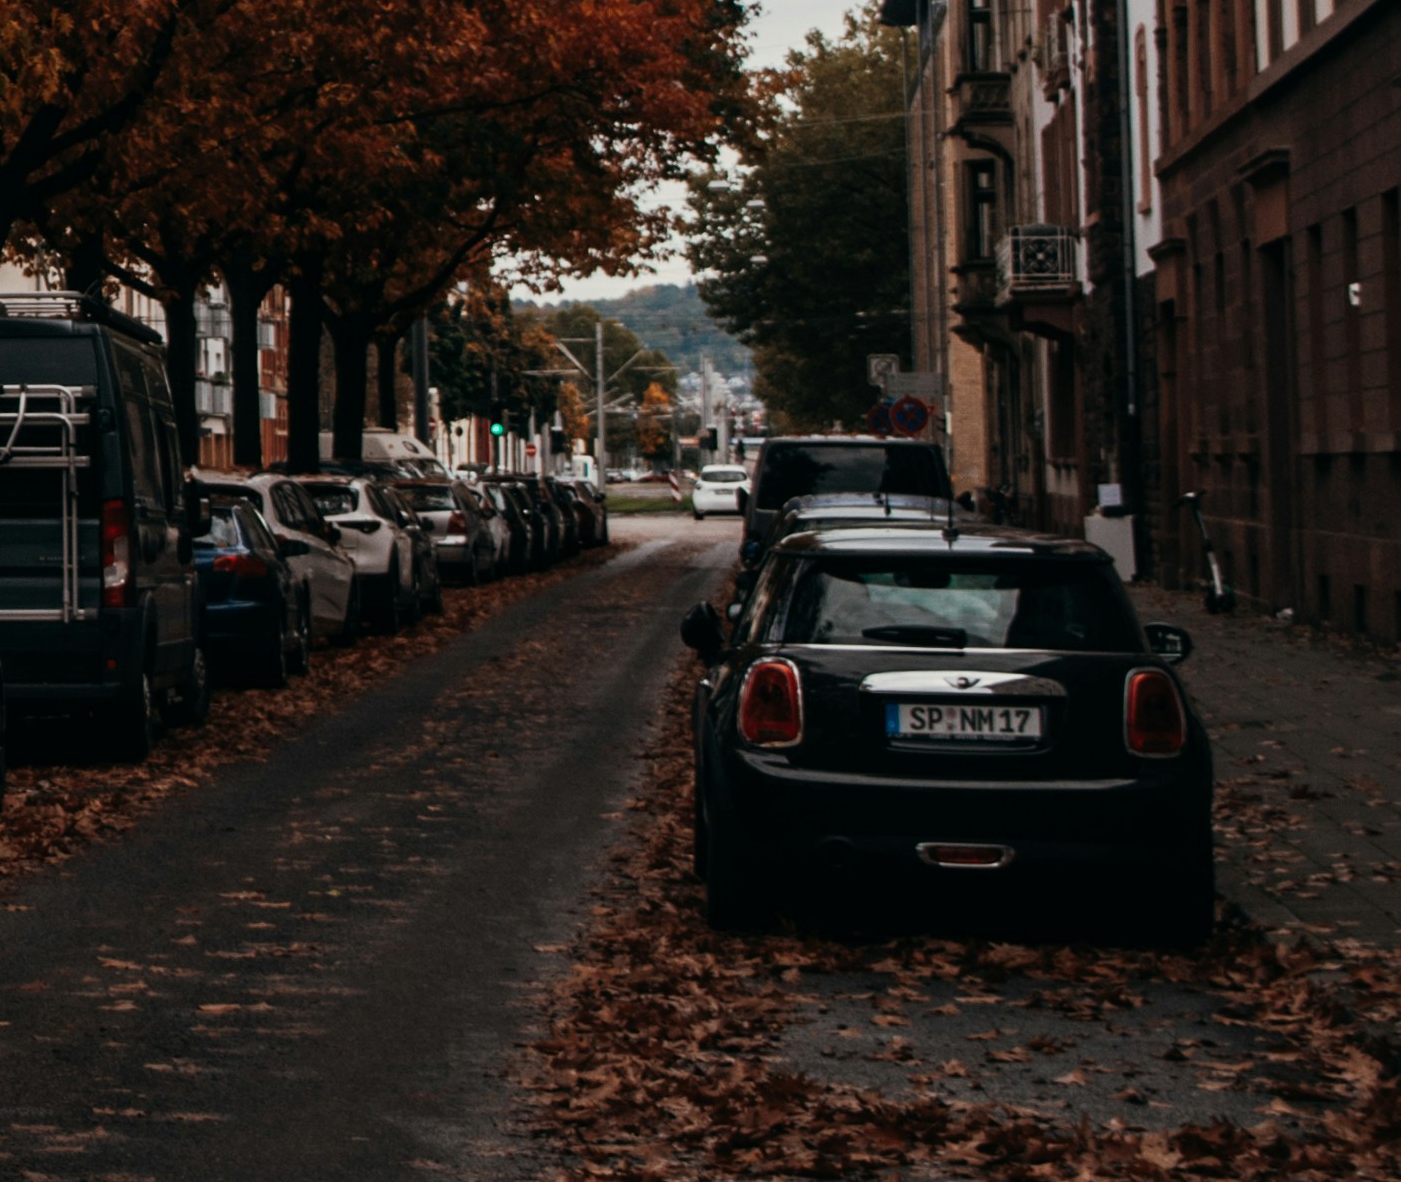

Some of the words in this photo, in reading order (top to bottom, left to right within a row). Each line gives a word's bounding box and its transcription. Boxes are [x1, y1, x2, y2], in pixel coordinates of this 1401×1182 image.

[910, 707, 942, 730] SP
[960, 708, 993, 732] NM
[999, 709, 1030, 733] 17
